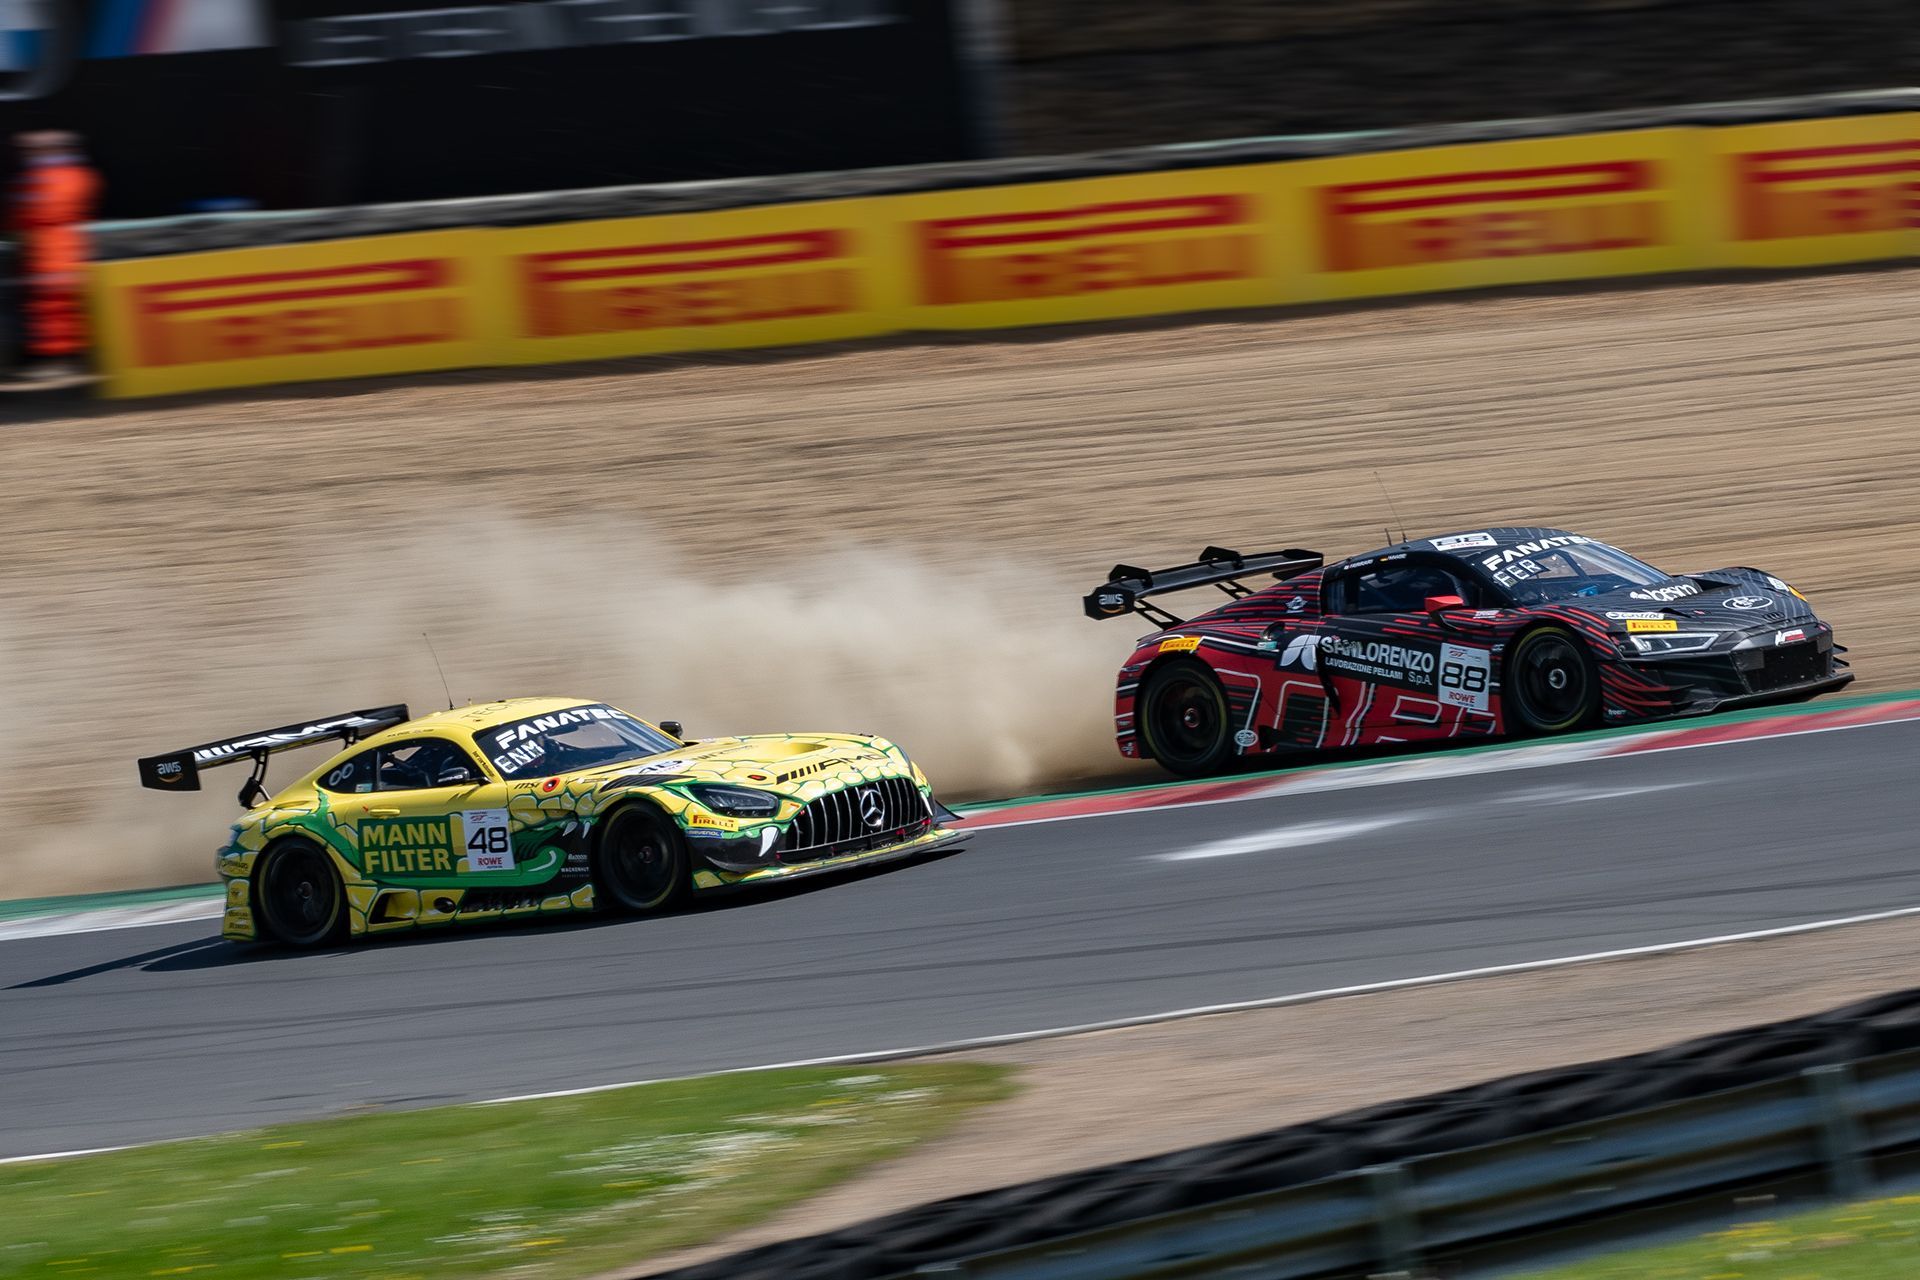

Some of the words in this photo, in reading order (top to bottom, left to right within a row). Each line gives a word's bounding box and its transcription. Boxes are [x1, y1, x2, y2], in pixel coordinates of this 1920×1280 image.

[1493, 559, 1541, 588] FER
[1322, 635, 1434, 673] SANLORENZO
[1325, 656, 1372, 674] LAVORAZIONE
[1373, 665, 1403, 680] PELLAMI
[1441, 661, 1487, 693] 88
[1448, 691, 1476, 704] ROWE
[495, 708, 629, 750] FANATEC
[158, 761, 182, 774] aws
[693, 814, 734, 828] PIRELLI
[363, 822, 448, 847] MANN
[467, 826, 508, 854] 48
[364, 848, 452, 874] FILTER
[477, 857, 503, 866] ROWE
